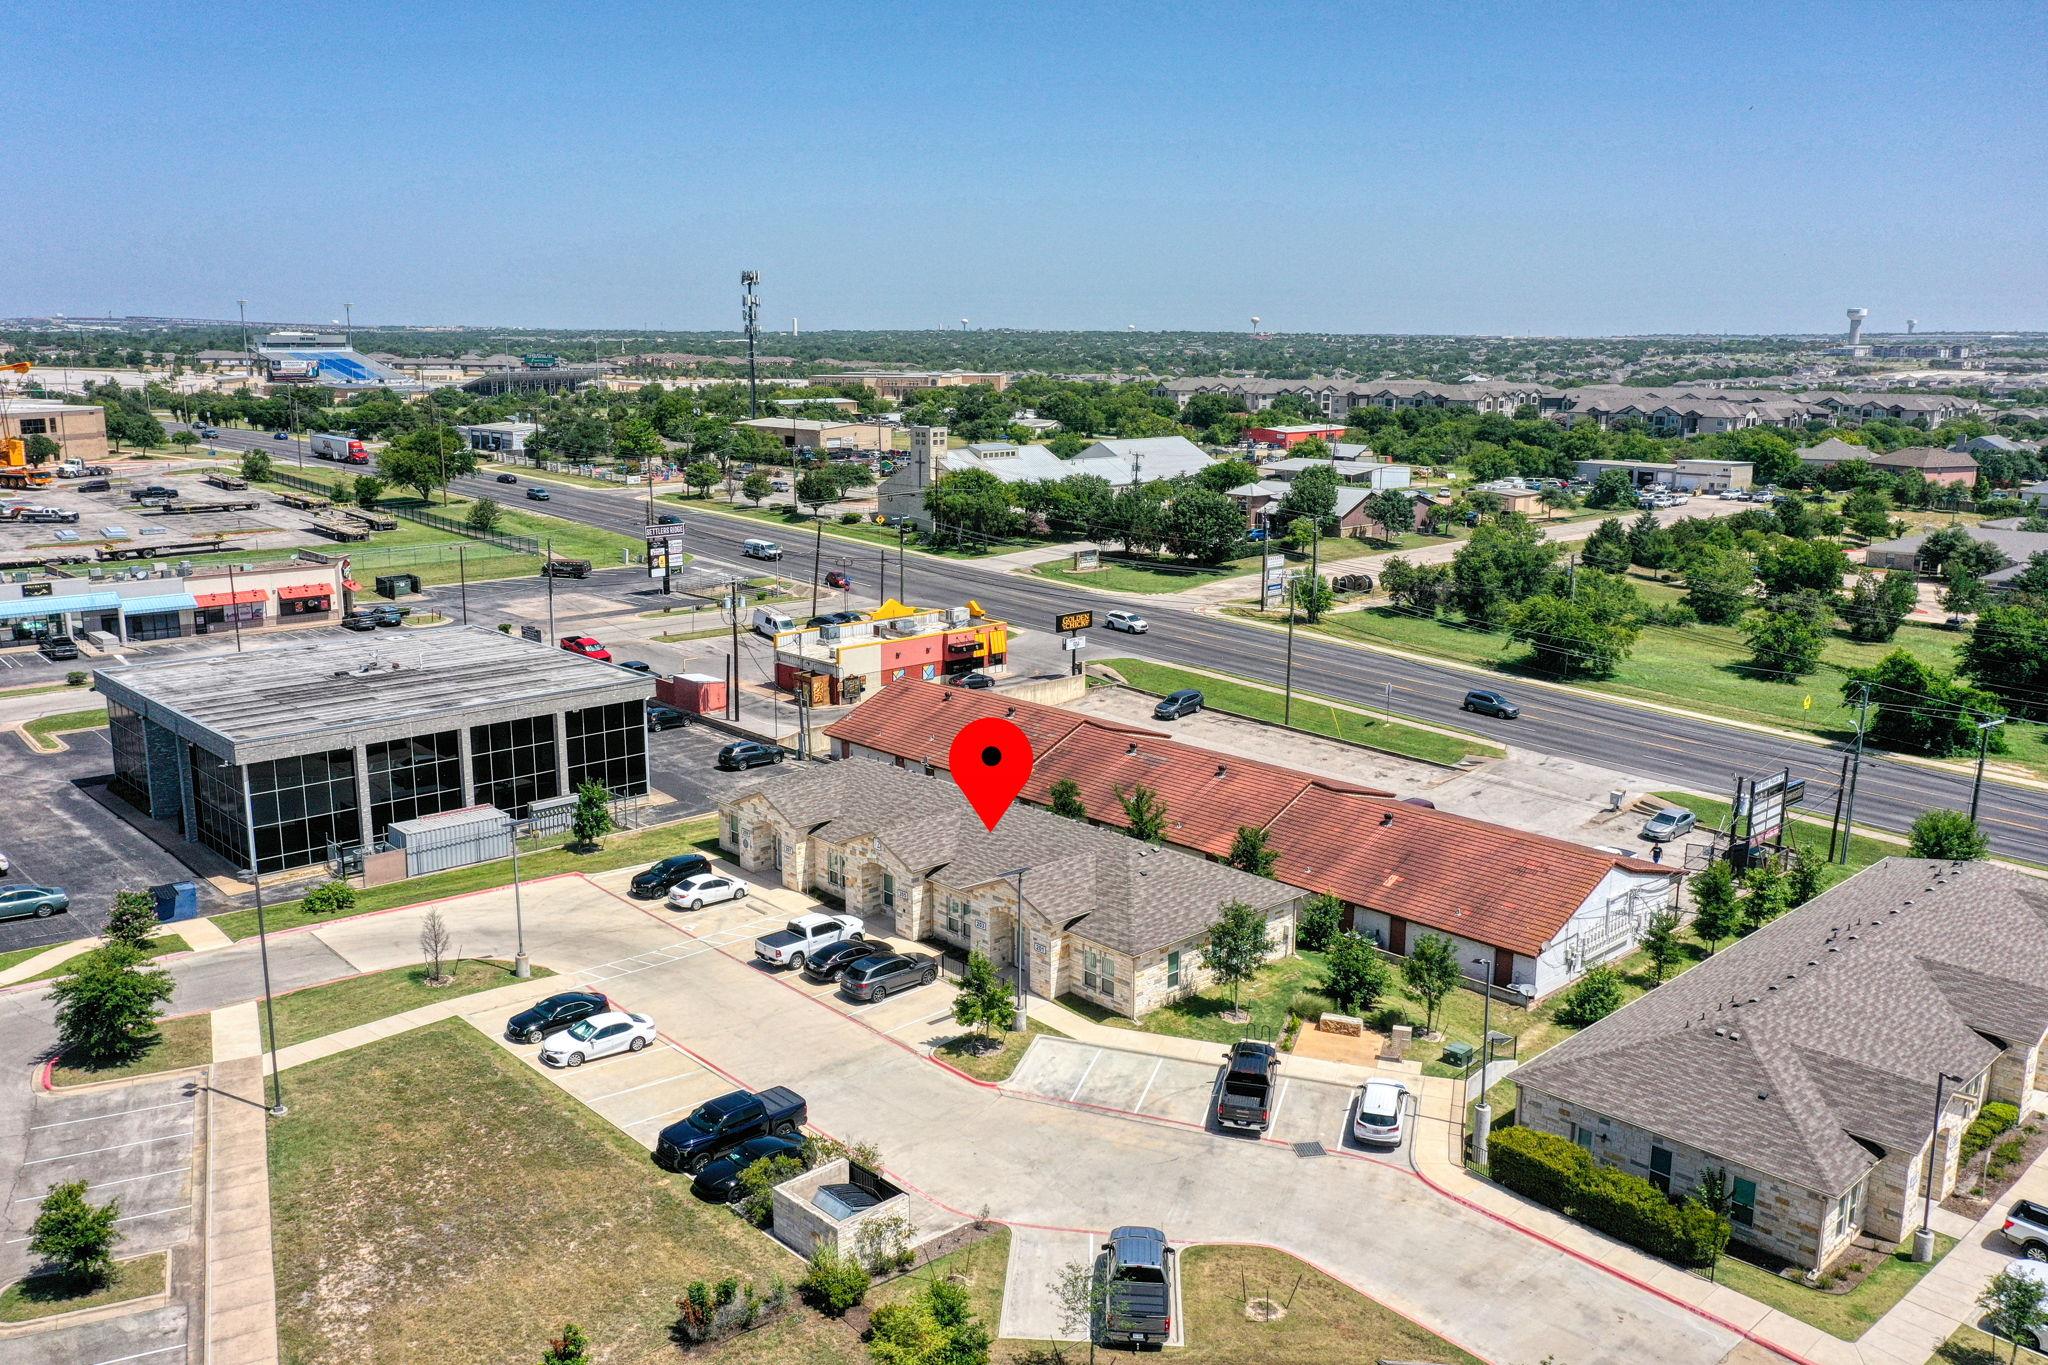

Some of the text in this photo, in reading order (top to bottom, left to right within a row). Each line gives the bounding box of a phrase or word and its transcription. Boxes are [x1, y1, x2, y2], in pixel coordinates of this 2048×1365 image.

[646, 525, 683, 536] SETTLERS RIDGE
[1062, 613, 1090, 624] GOLDEN
